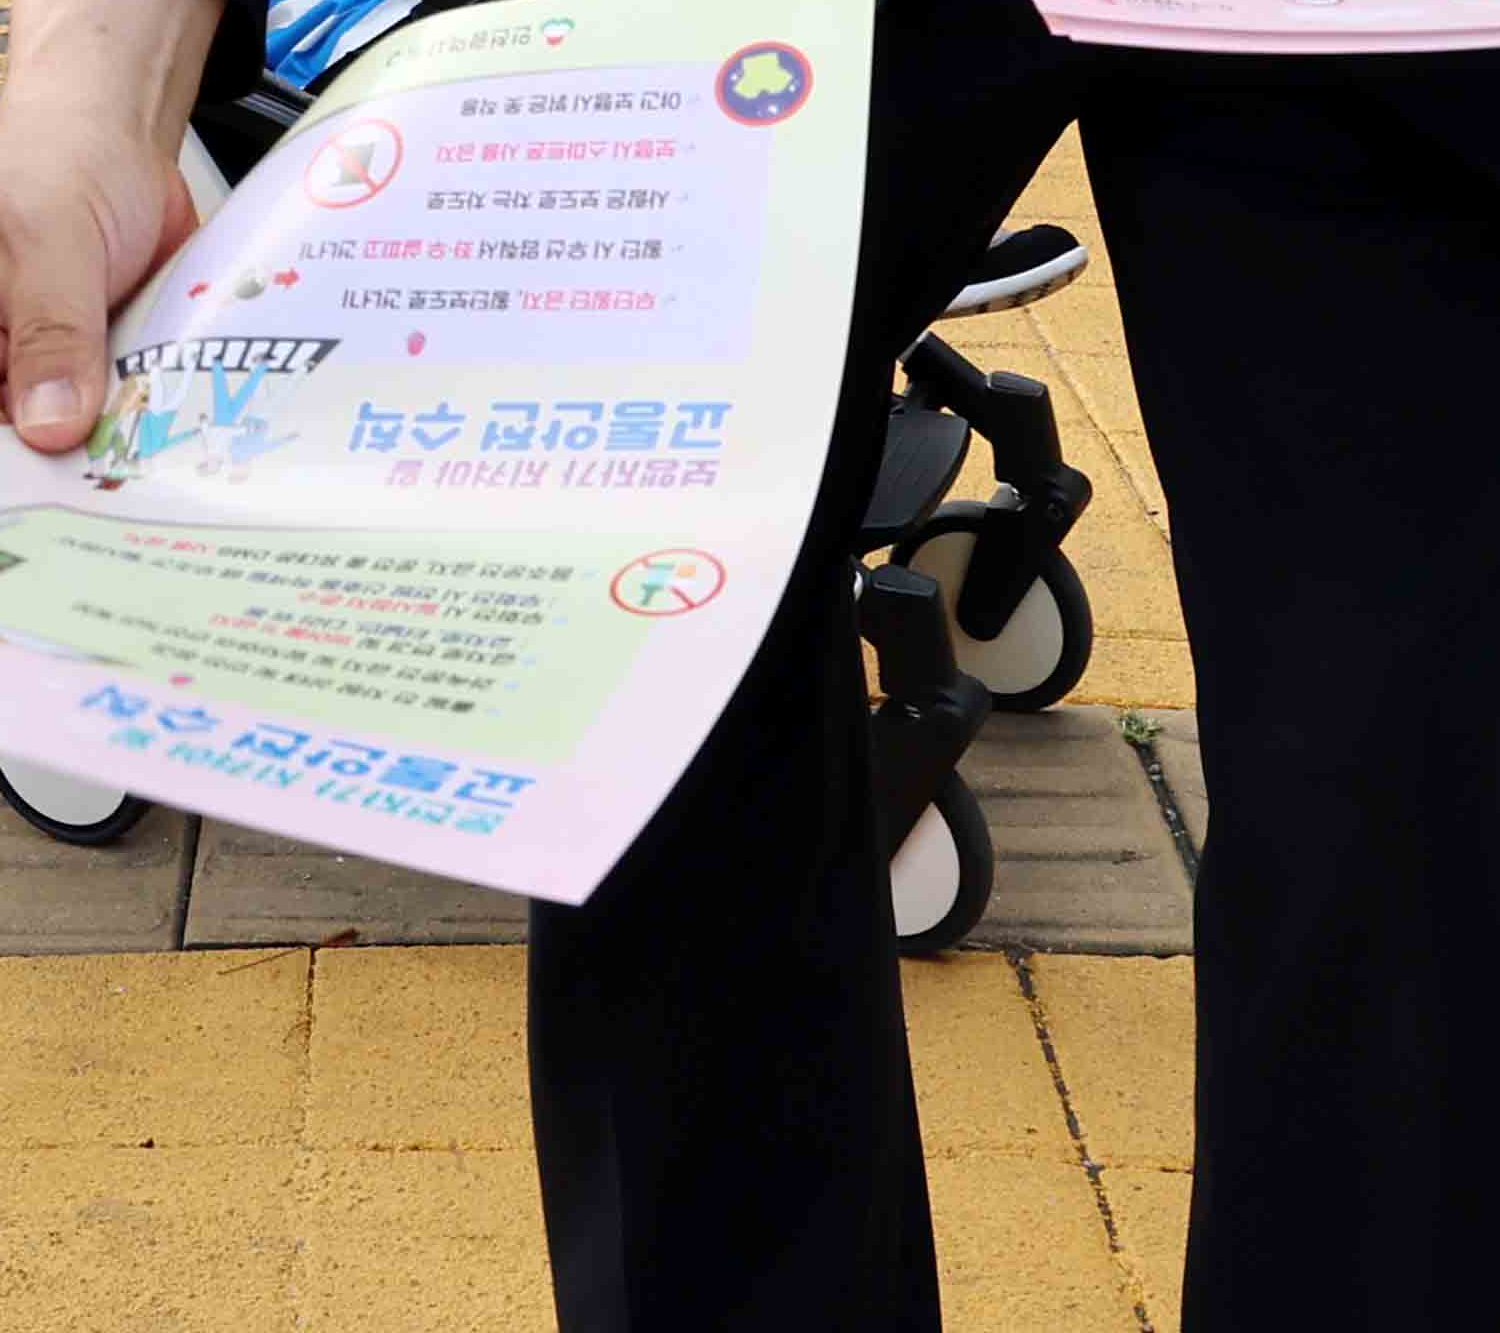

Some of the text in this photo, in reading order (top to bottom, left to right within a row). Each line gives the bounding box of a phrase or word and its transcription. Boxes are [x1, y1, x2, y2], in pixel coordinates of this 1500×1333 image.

[594, 239, 614, 259] 시
[348, 400, 733, 453] 교통안전 수칙
[431, 459, 549, 490] 지켜야
